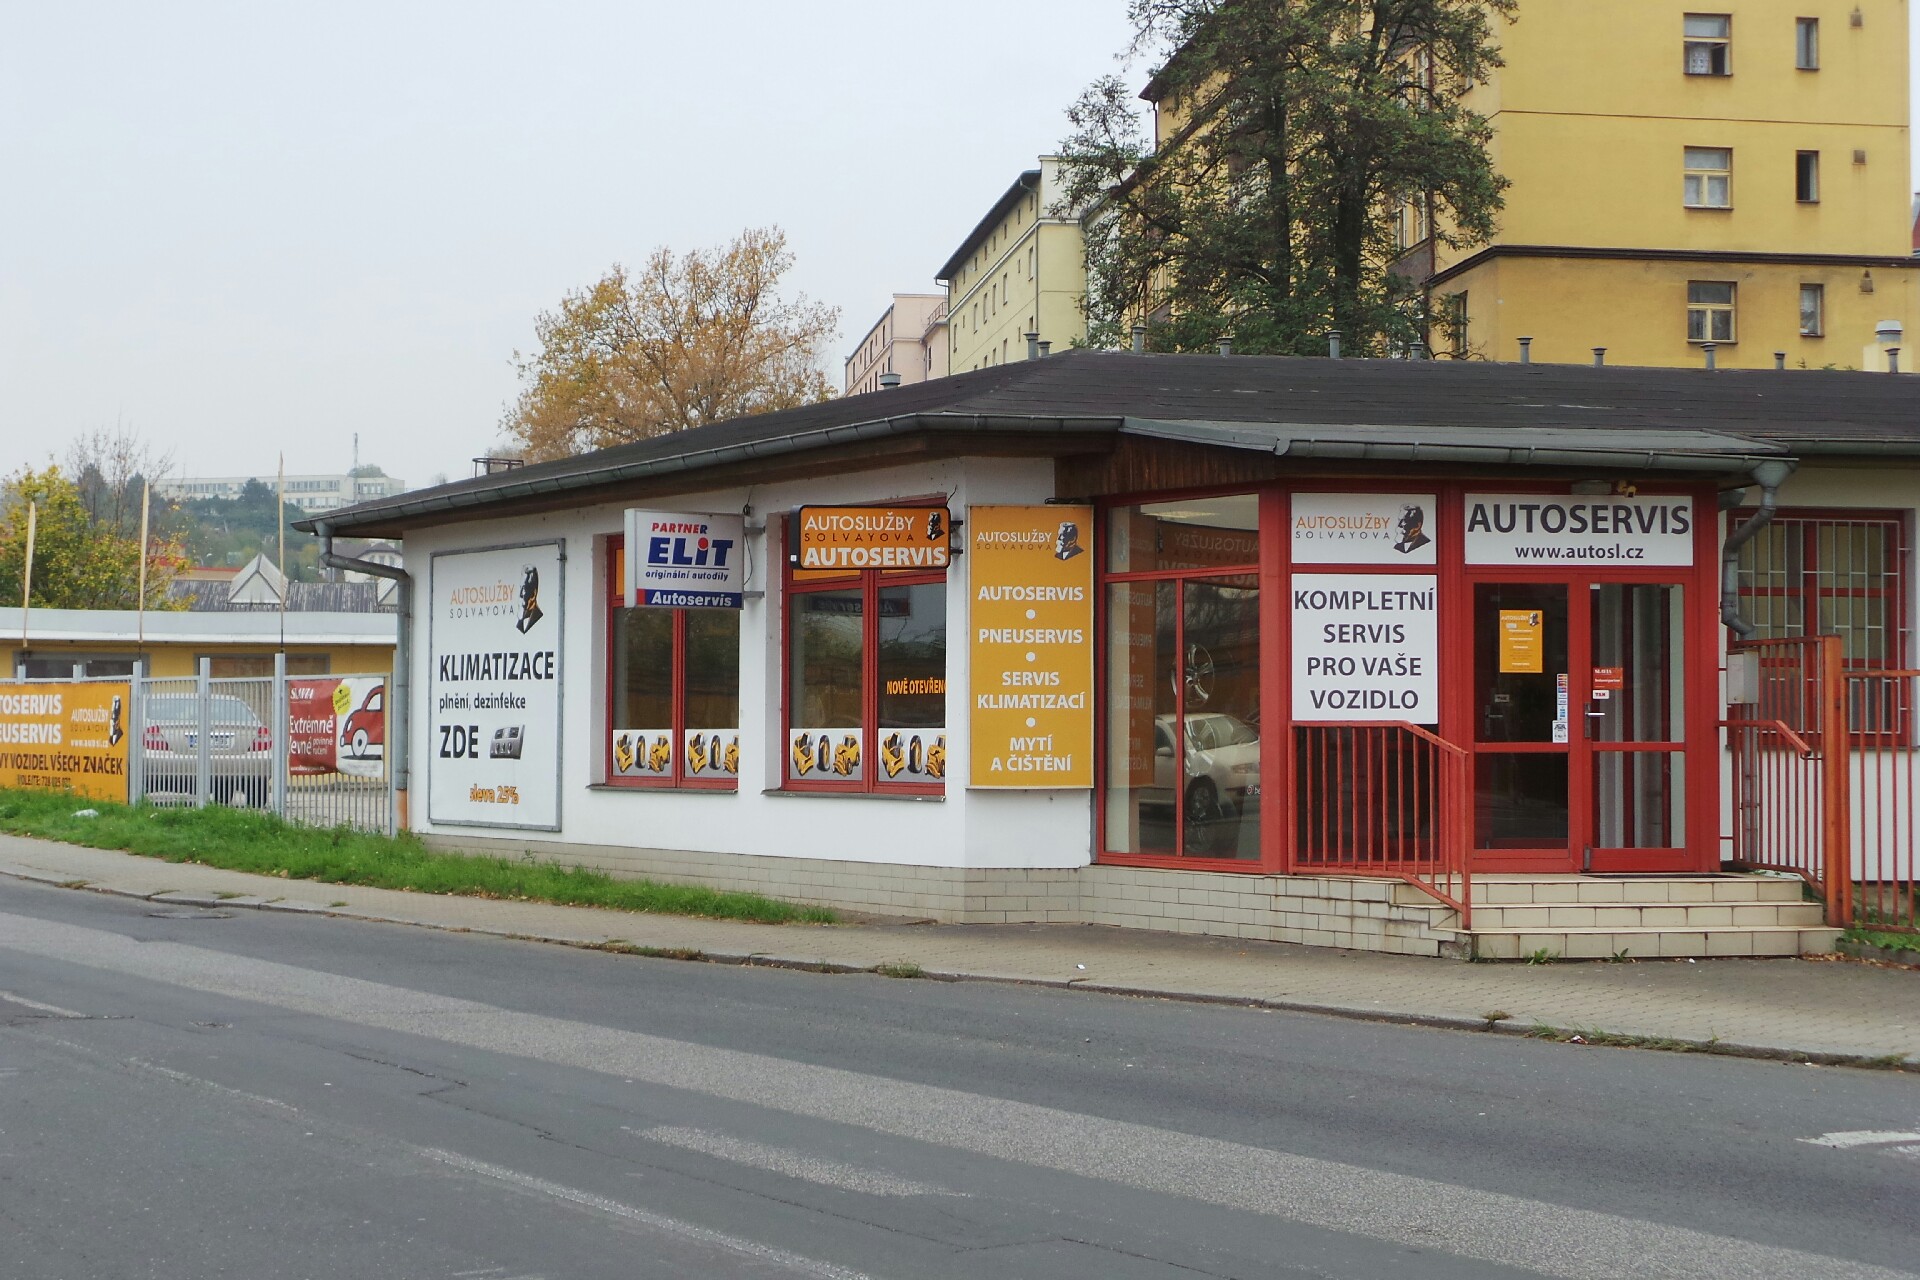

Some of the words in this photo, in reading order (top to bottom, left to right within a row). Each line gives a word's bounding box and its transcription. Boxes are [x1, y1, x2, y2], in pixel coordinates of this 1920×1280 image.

[804, 512, 914, 531] AUTOSLUŽBY
[1295, 513, 1390, 530] AUTOSLUŽBY
[1467, 503, 1690, 534] AUTOSERVIS
[651, 523, 708, 534] PARTNER
[976, 529, 1052, 543] AUTOSLUŽBY
[1295, 531, 1390, 539] SOLVAYOVA
[804, 533, 914, 542] SOLVAYOVA
[803, 547, 946, 566] AUTOSERVIS
[1515, 544, 1644, 559] www.autosl.cz
[645, 570, 690, 580] originální
[692, 572, 729, 582] autodíly
[450, 579, 515, 605] AUTOSLUŽBY
[651, 591, 732, 606] Autoservis
[978, 586, 1084, 601] AUTOSERVIS
[1294, 587, 1434, 611] KOMPLETNÍ
[450, 605, 515, 618] SOLVAYOVA
[978, 629, 1083, 644] PNEUSERVIS
[1323, 624, 1405, 643] SERVIS
[440, 651, 554, 682] KLIMATIZACE
[1307, 657, 1356, 676] PRO
[1362, 653, 1422, 677] VAŠE
[909, 677, 946, 695] OTEVŘEN
[1002, 671, 1060, 686] SERVIS
[473, 692, 526, 709] dezinfekce
[977, 691, 1085, 709] KLIMATIZACÍ
[1310, 690, 1419, 709] VOZIDLO
[290, 714, 334, 734] Extrémně
[288, 735, 312, 755] levné
[440, 725, 479, 759] ZDE
[1009, 734, 1053, 751] MYTÍ
[10, 753, 48, 771] VOZIDEL
[50, 751, 80, 772] VŠECH
[83, 753, 123, 775] ZNAČEK
[990, 757, 1002, 771] A
[1006, 754, 1071, 771] ČIŠTĚNÍ
